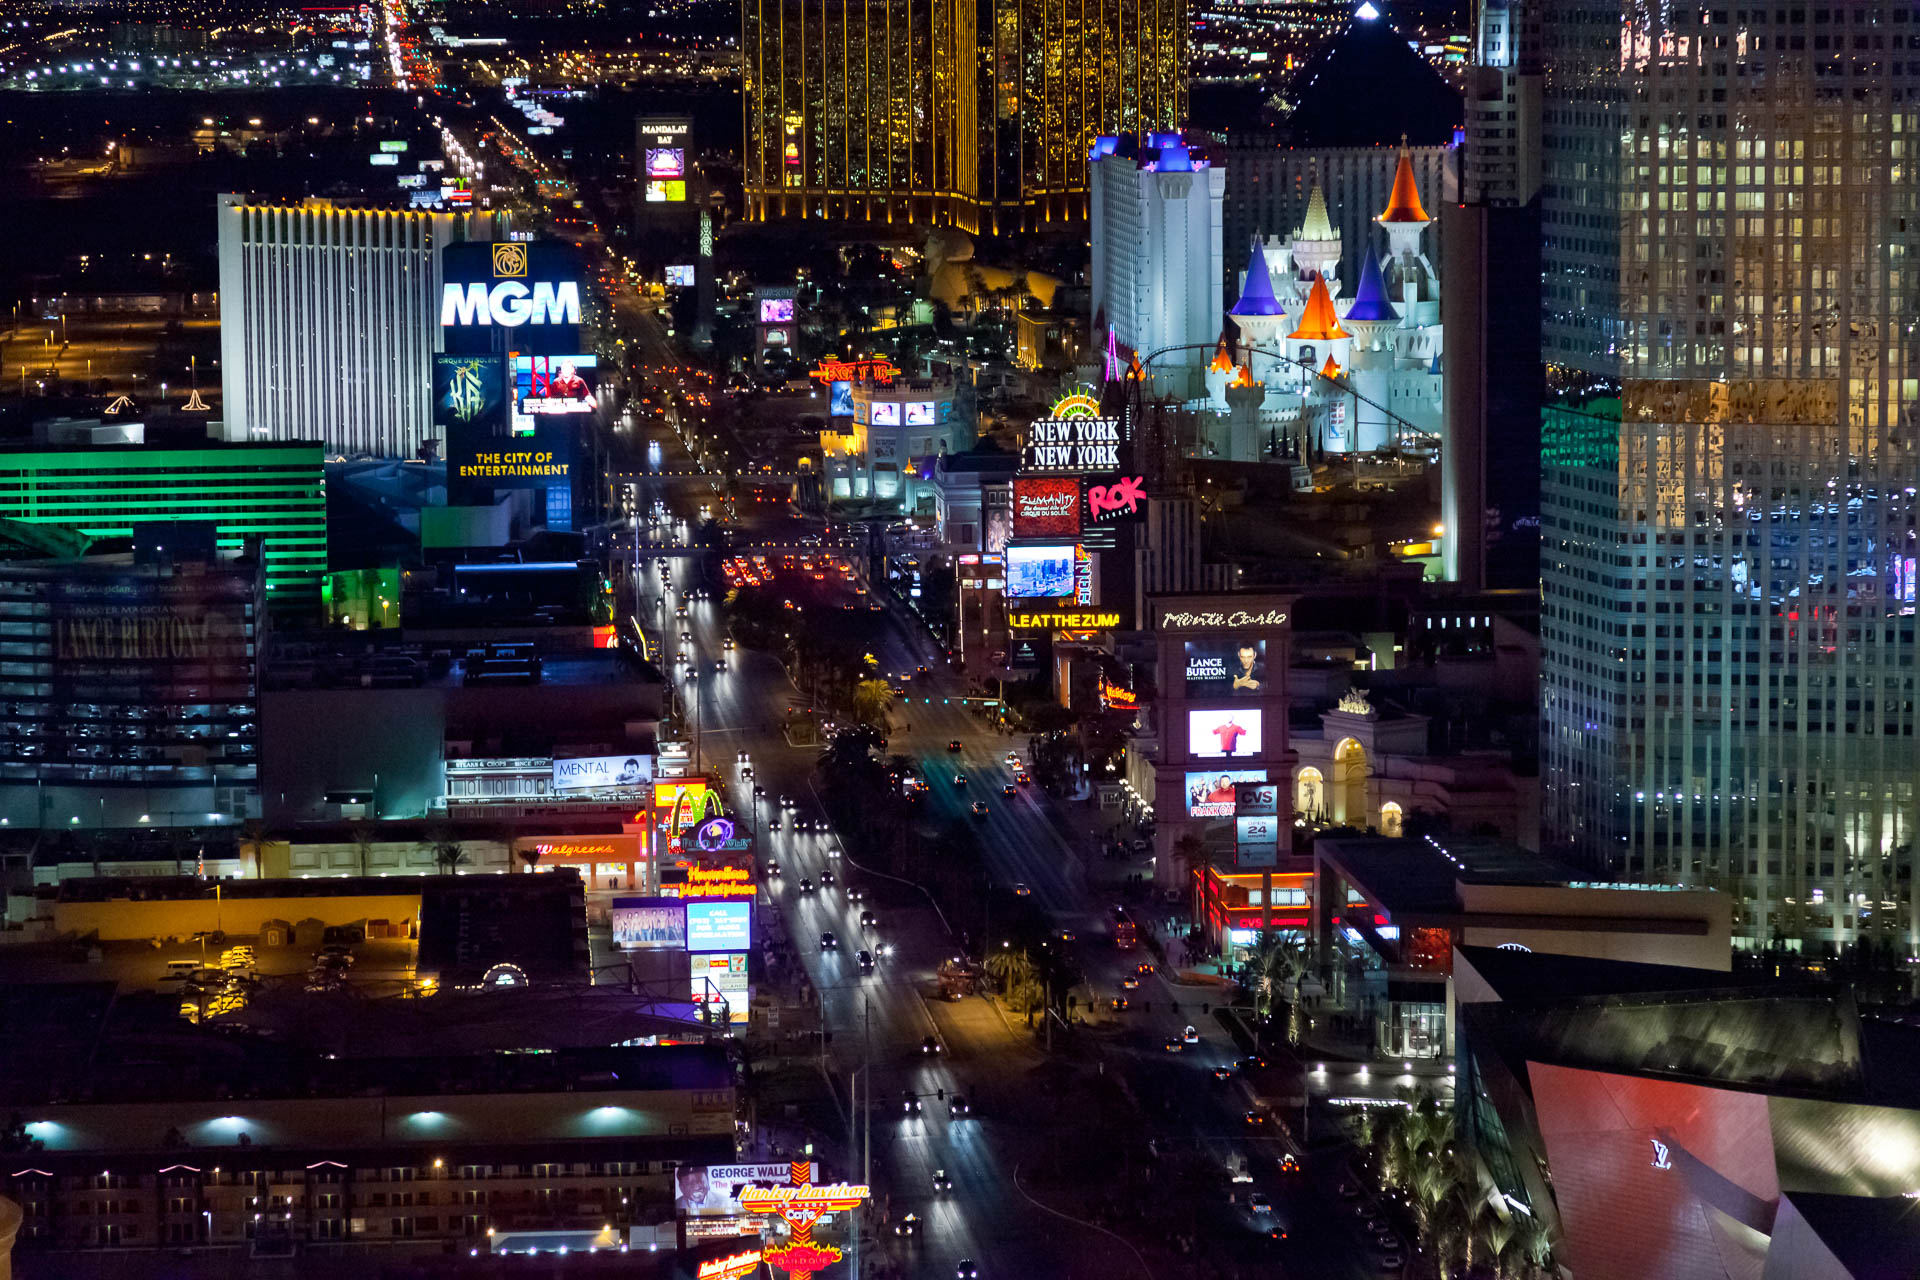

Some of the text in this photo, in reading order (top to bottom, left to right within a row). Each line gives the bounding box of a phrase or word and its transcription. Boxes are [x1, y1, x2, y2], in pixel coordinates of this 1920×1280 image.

[642, 125, 688, 134] MANDALAY
[657, 136, 673, 144] BAY
[700, 211, 713, 257] LUXOR
[440, 281, 583, 327] MGM
[1034, 421, 1120, 441] NEW YORK
[476, 452, 553, 464] THE CITY OF
[1034, 445, 1120, 466] NEW YORK
[459, 464, 569, 476] ENTERTAINMENT
[1019, 492, 1077, 510] ZUMANITY
[1088, 476, 1147, 523] ROK
[1030, 615, 1050, 627] AT
[1052, 615, 1080, 627] THE
[1162, 609, 1287, 629] Monte Carlo
[58, 616, 196, 659] LANCE BURTON
[1190, 658, 1222, 667] LANCE
[1186, 667, 1227, 677] BURTON
[559, 761, 609, 777] MENTAL
[1241, 791, 1273, 804] CVS
[1191, 806, 1219, 817] FRANK
[1247, 826, 1268, 835] 24
[535, 844, 615, 857] Walgreens
[1239, 917, 1264, 929] CVS
[711, 1166, 791, 1178] GEORGE WALLA
